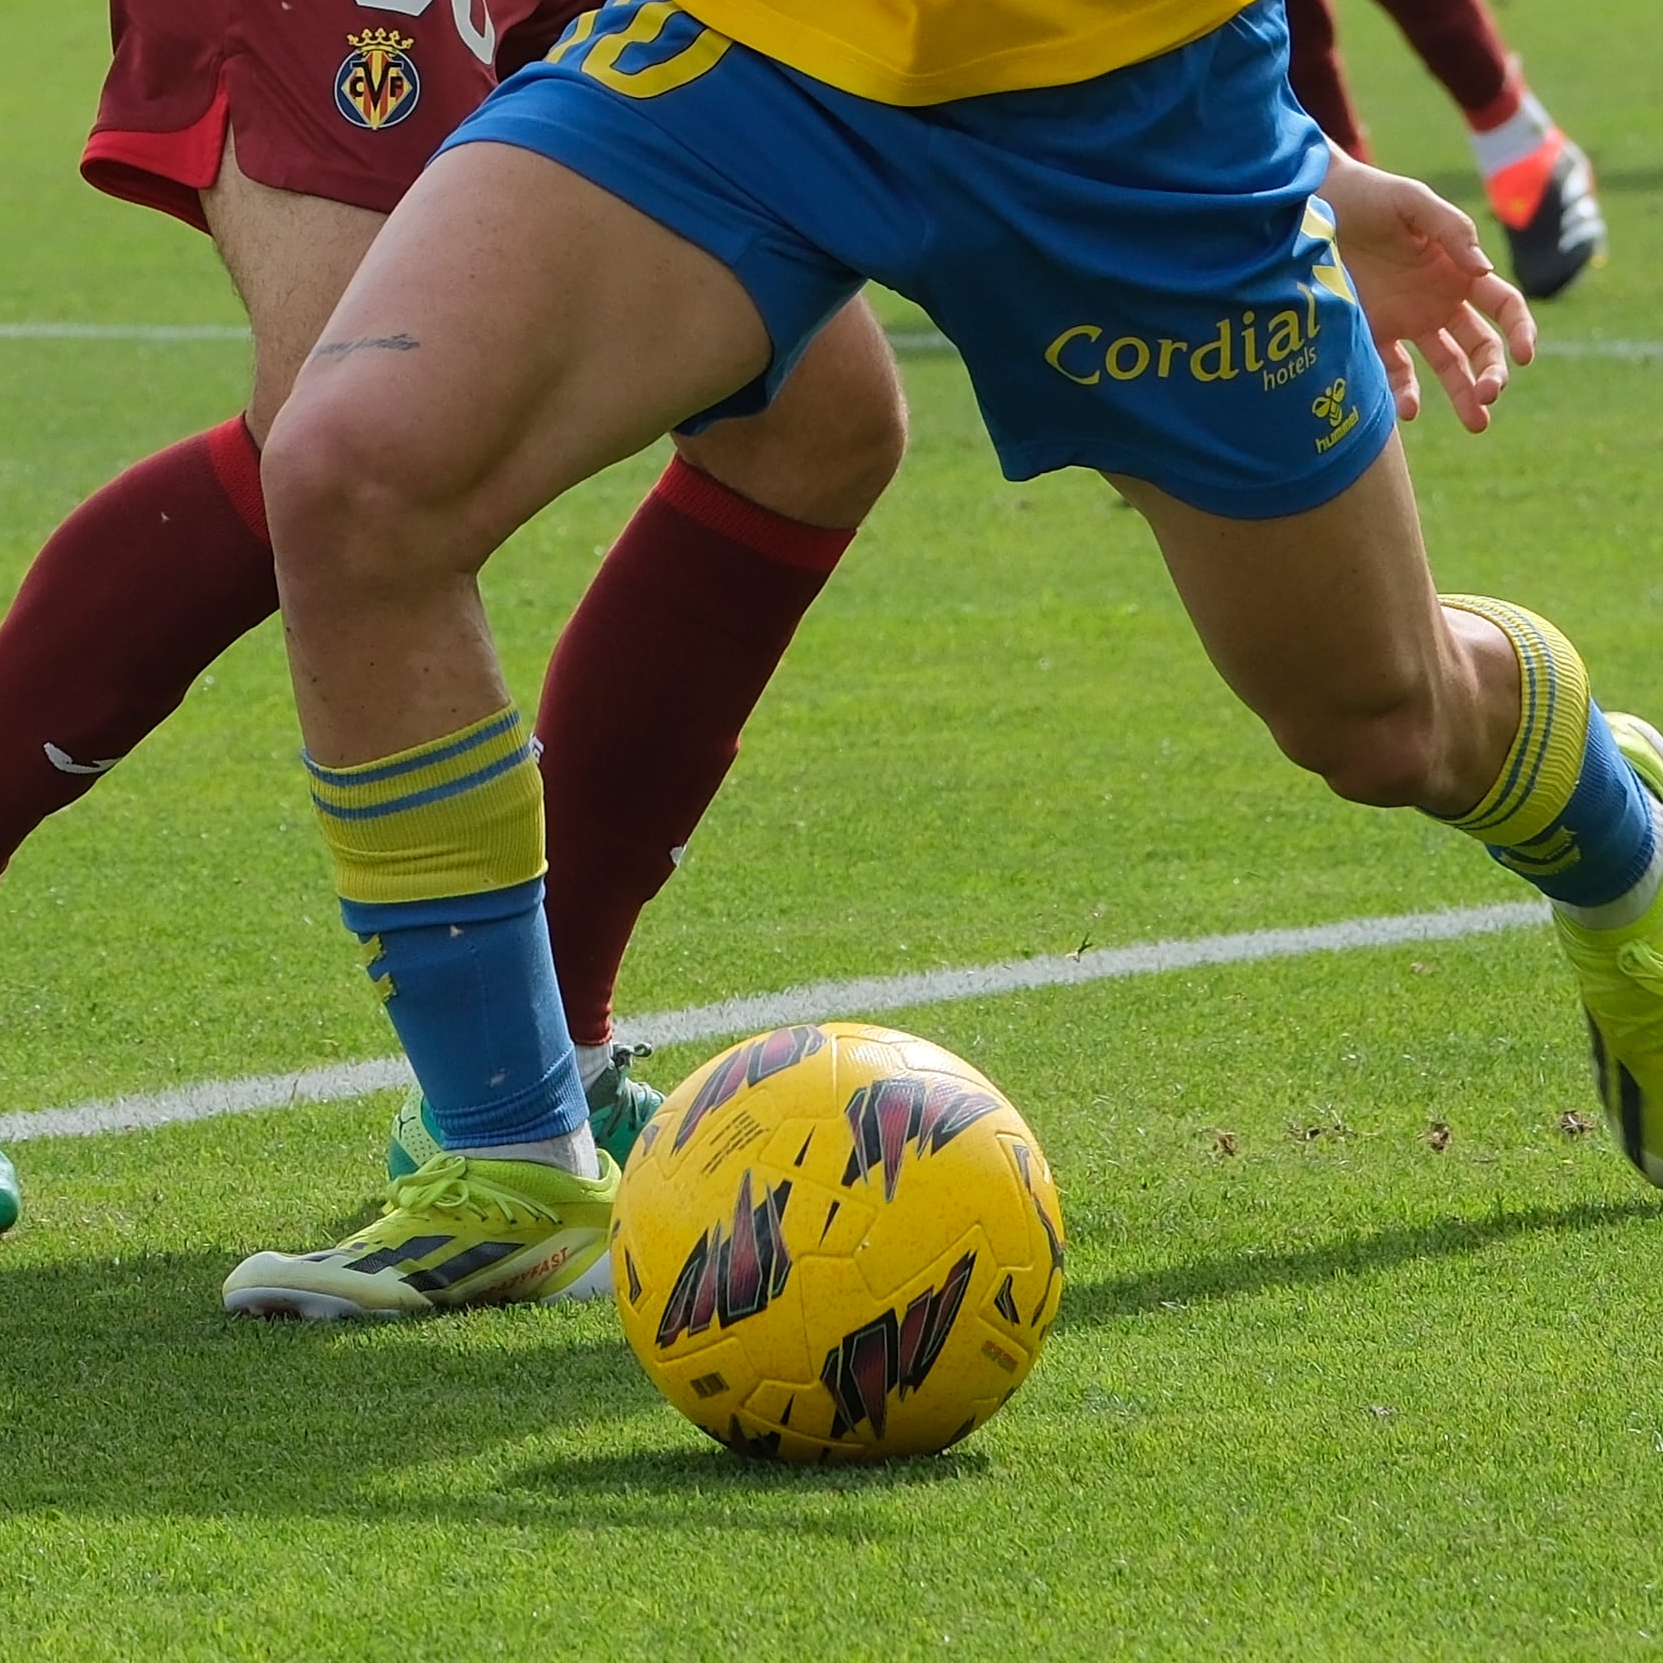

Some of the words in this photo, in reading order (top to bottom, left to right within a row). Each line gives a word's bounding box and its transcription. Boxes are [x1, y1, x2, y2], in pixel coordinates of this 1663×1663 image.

[1043, 281, 1321, 385] Cordial
[1263, 345, 1318, 392] hotels
[1315, 404, 1360, 455] hummel
